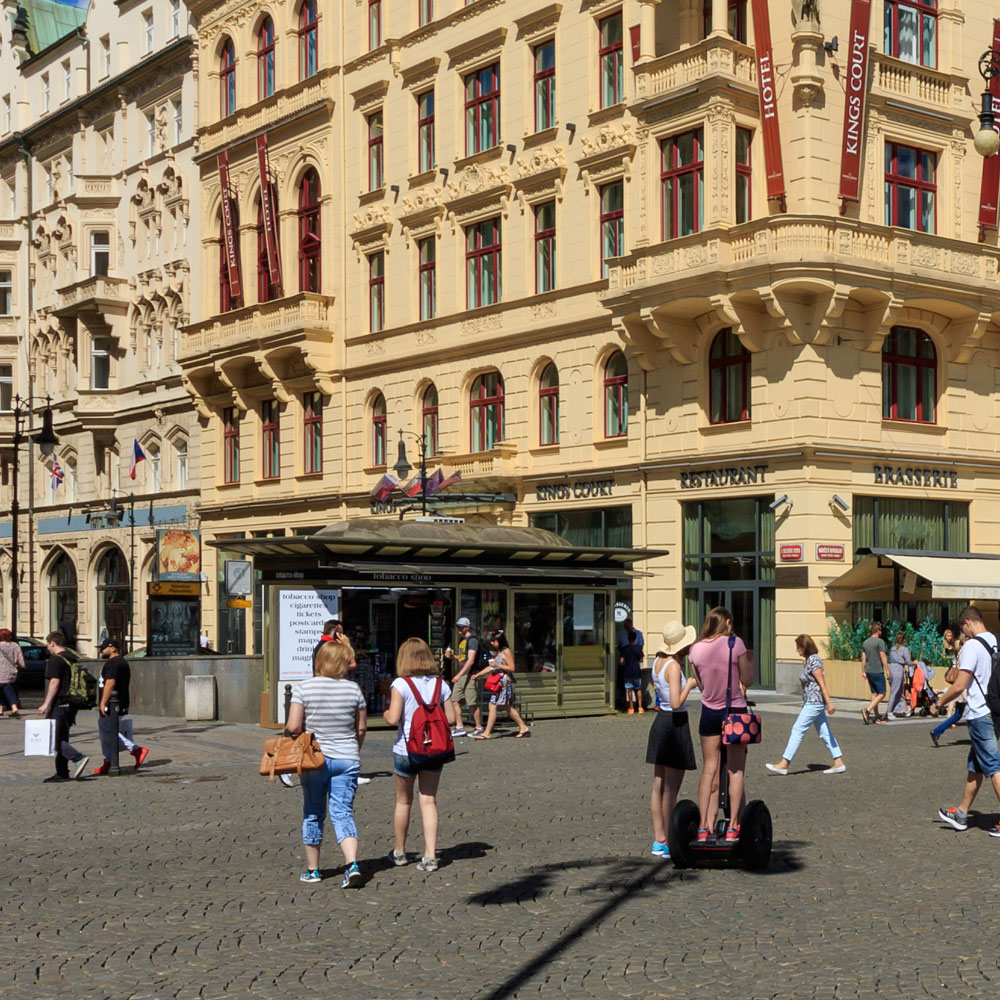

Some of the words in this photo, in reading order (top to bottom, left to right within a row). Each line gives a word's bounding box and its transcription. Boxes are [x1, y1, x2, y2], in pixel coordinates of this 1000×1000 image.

[850, 30, 866, 92] COURT
[760, 51, 776, 119] HOTEL
[846, 95, 861, 154] KINGS
[223, 189, 231, 226] COURT
[228, 230, 236, 267] KINGS
[680, 465, 768, 489] RESTAURANT
[873, 465, 958, 488] BRASSERIE
[536, 485, 571, 501] KINGS
[573, 479, 615, 498] COURT
[373, 572, 409, 580] tobacco
[290, 602, 328, 610] cigarettes
[316, 594, 336, 602] shop
